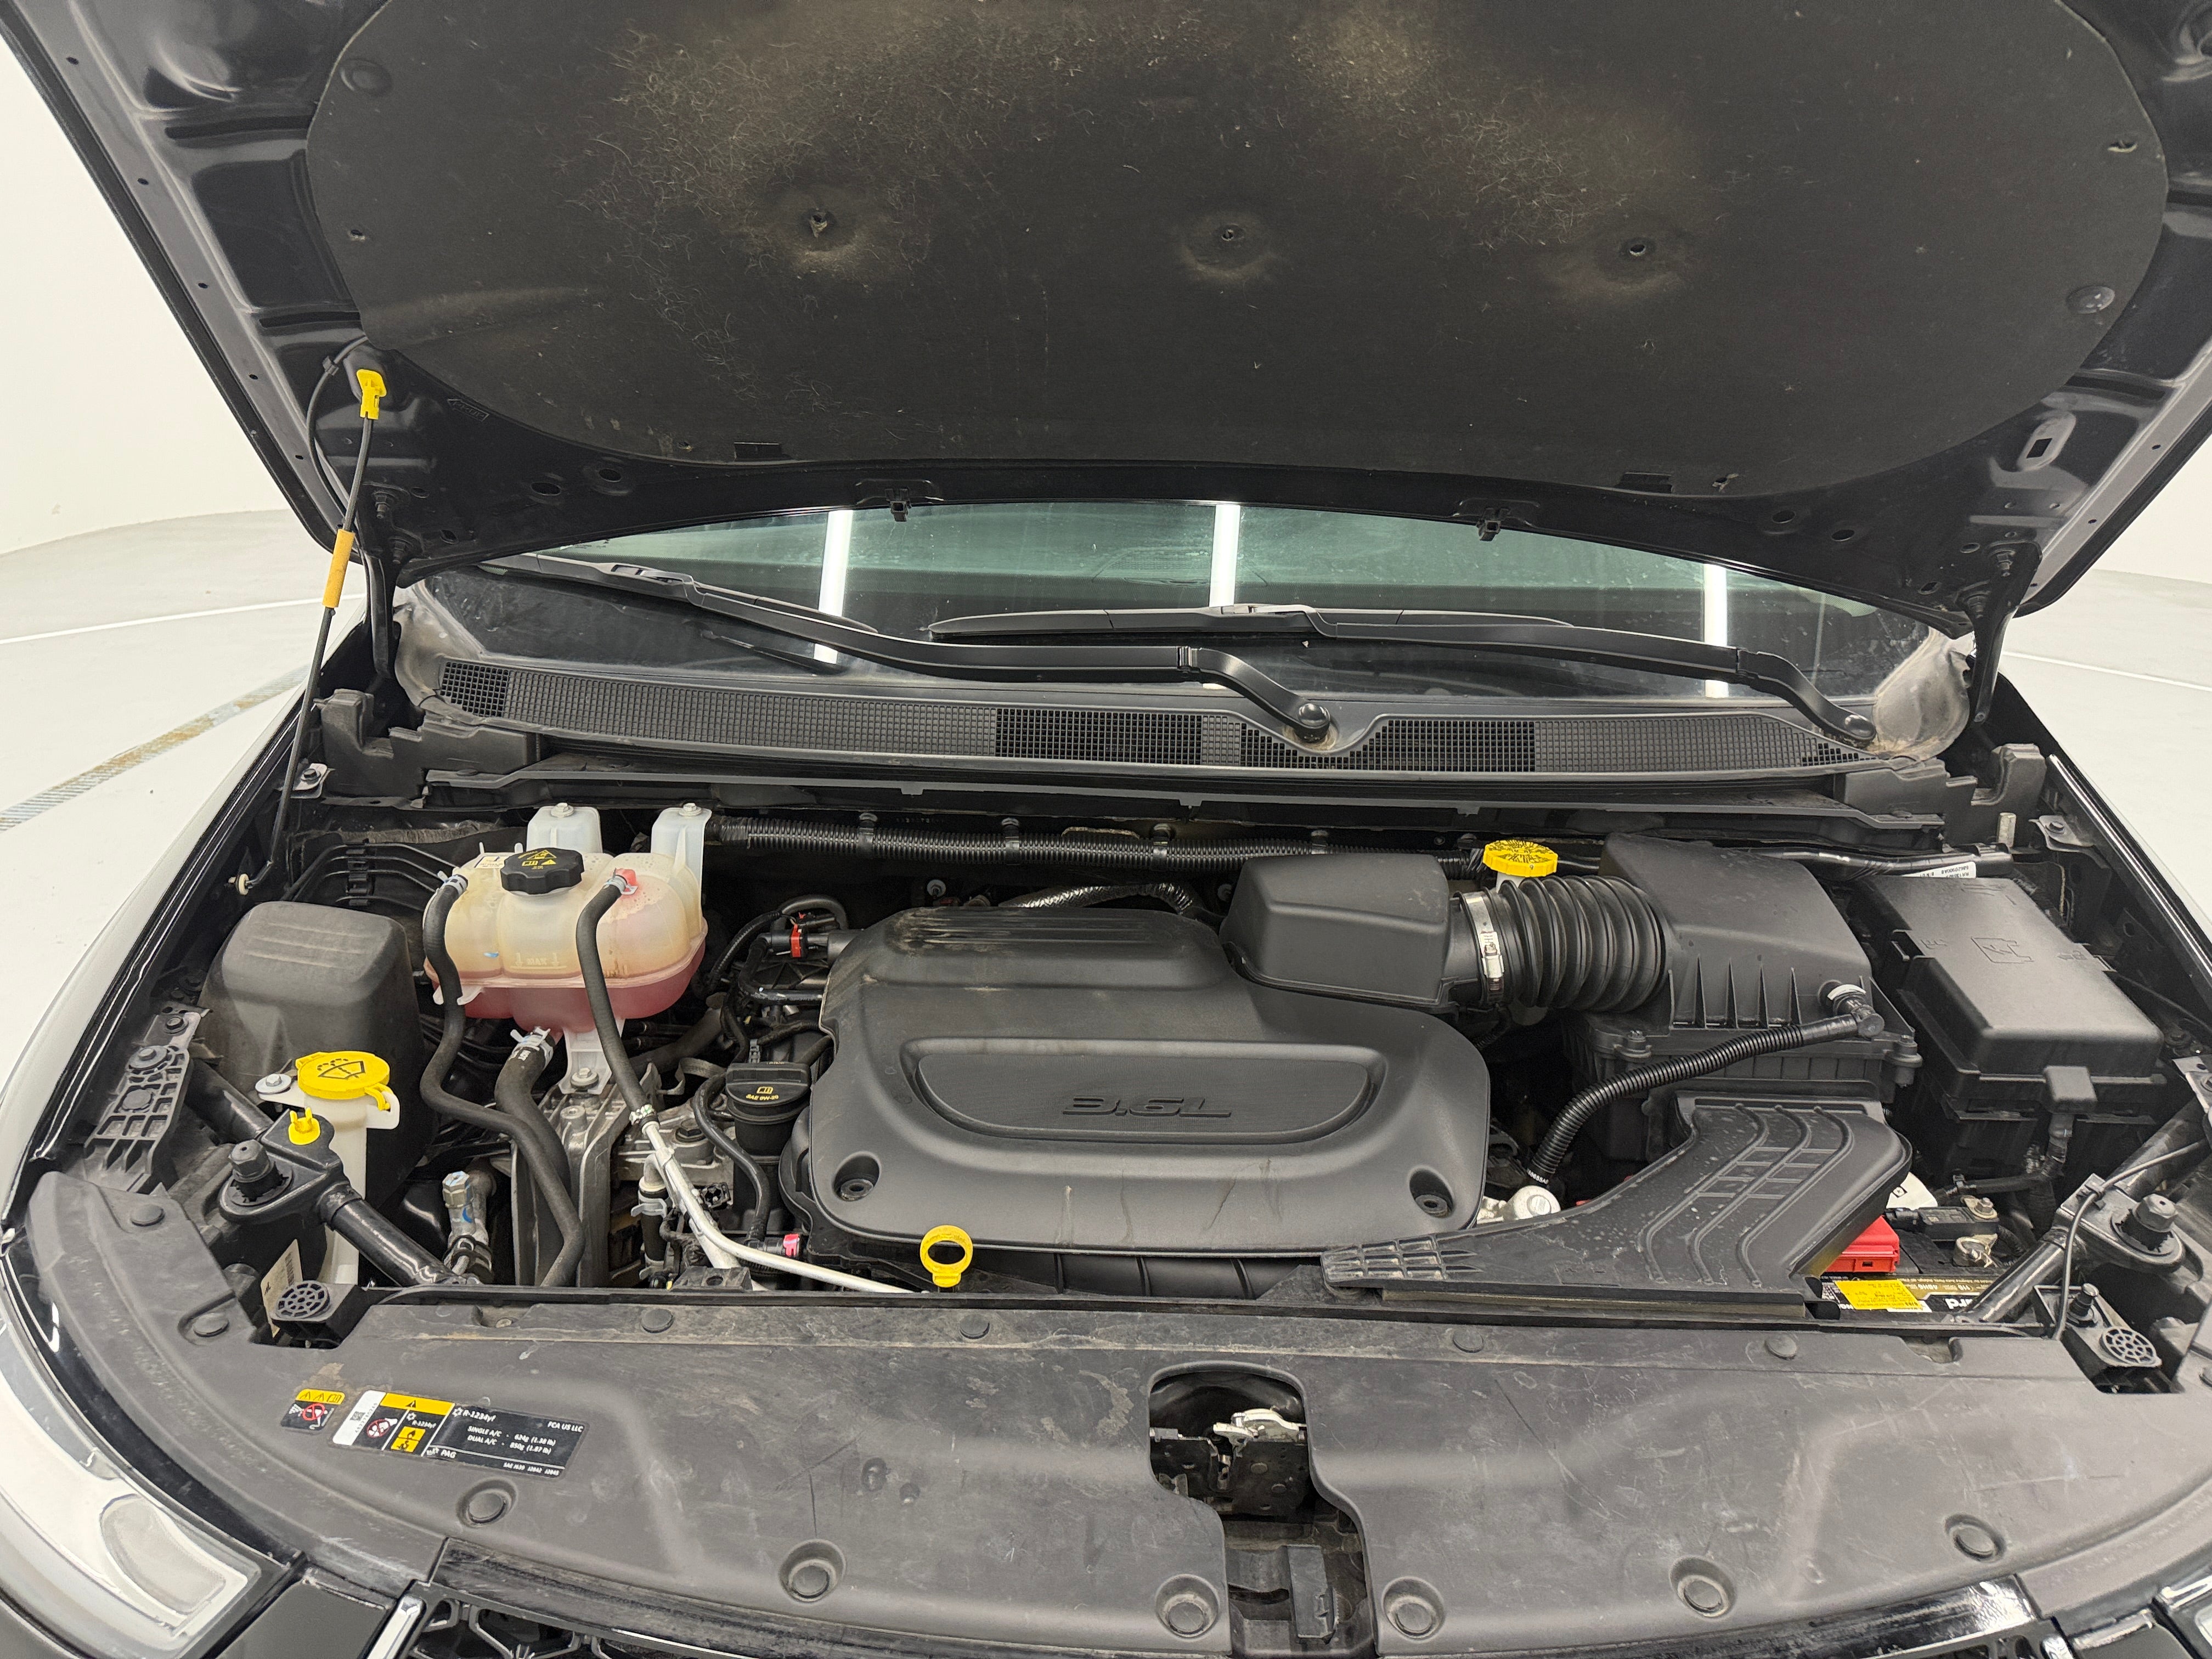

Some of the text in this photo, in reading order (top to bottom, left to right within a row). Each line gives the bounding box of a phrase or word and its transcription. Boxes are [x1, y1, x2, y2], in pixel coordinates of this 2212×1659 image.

[526, 957, 548, 966] MAX
[1062, 1097, 1232, 1118] 3.6L
[462, 1409, 496, 1423] R-1234yf
[548, 1421, 561, 1429] FCA
[467, 1425, 490, 1435] SINGLE
[489, 1429, 503, 1437] A/C
[514, 1434, 529, 1443] 624g
[467, 1434, 484, 1443] DUAL
[484, 1437, 498, 1446] A/C
[441, 1449, 457, 1458] PAG
